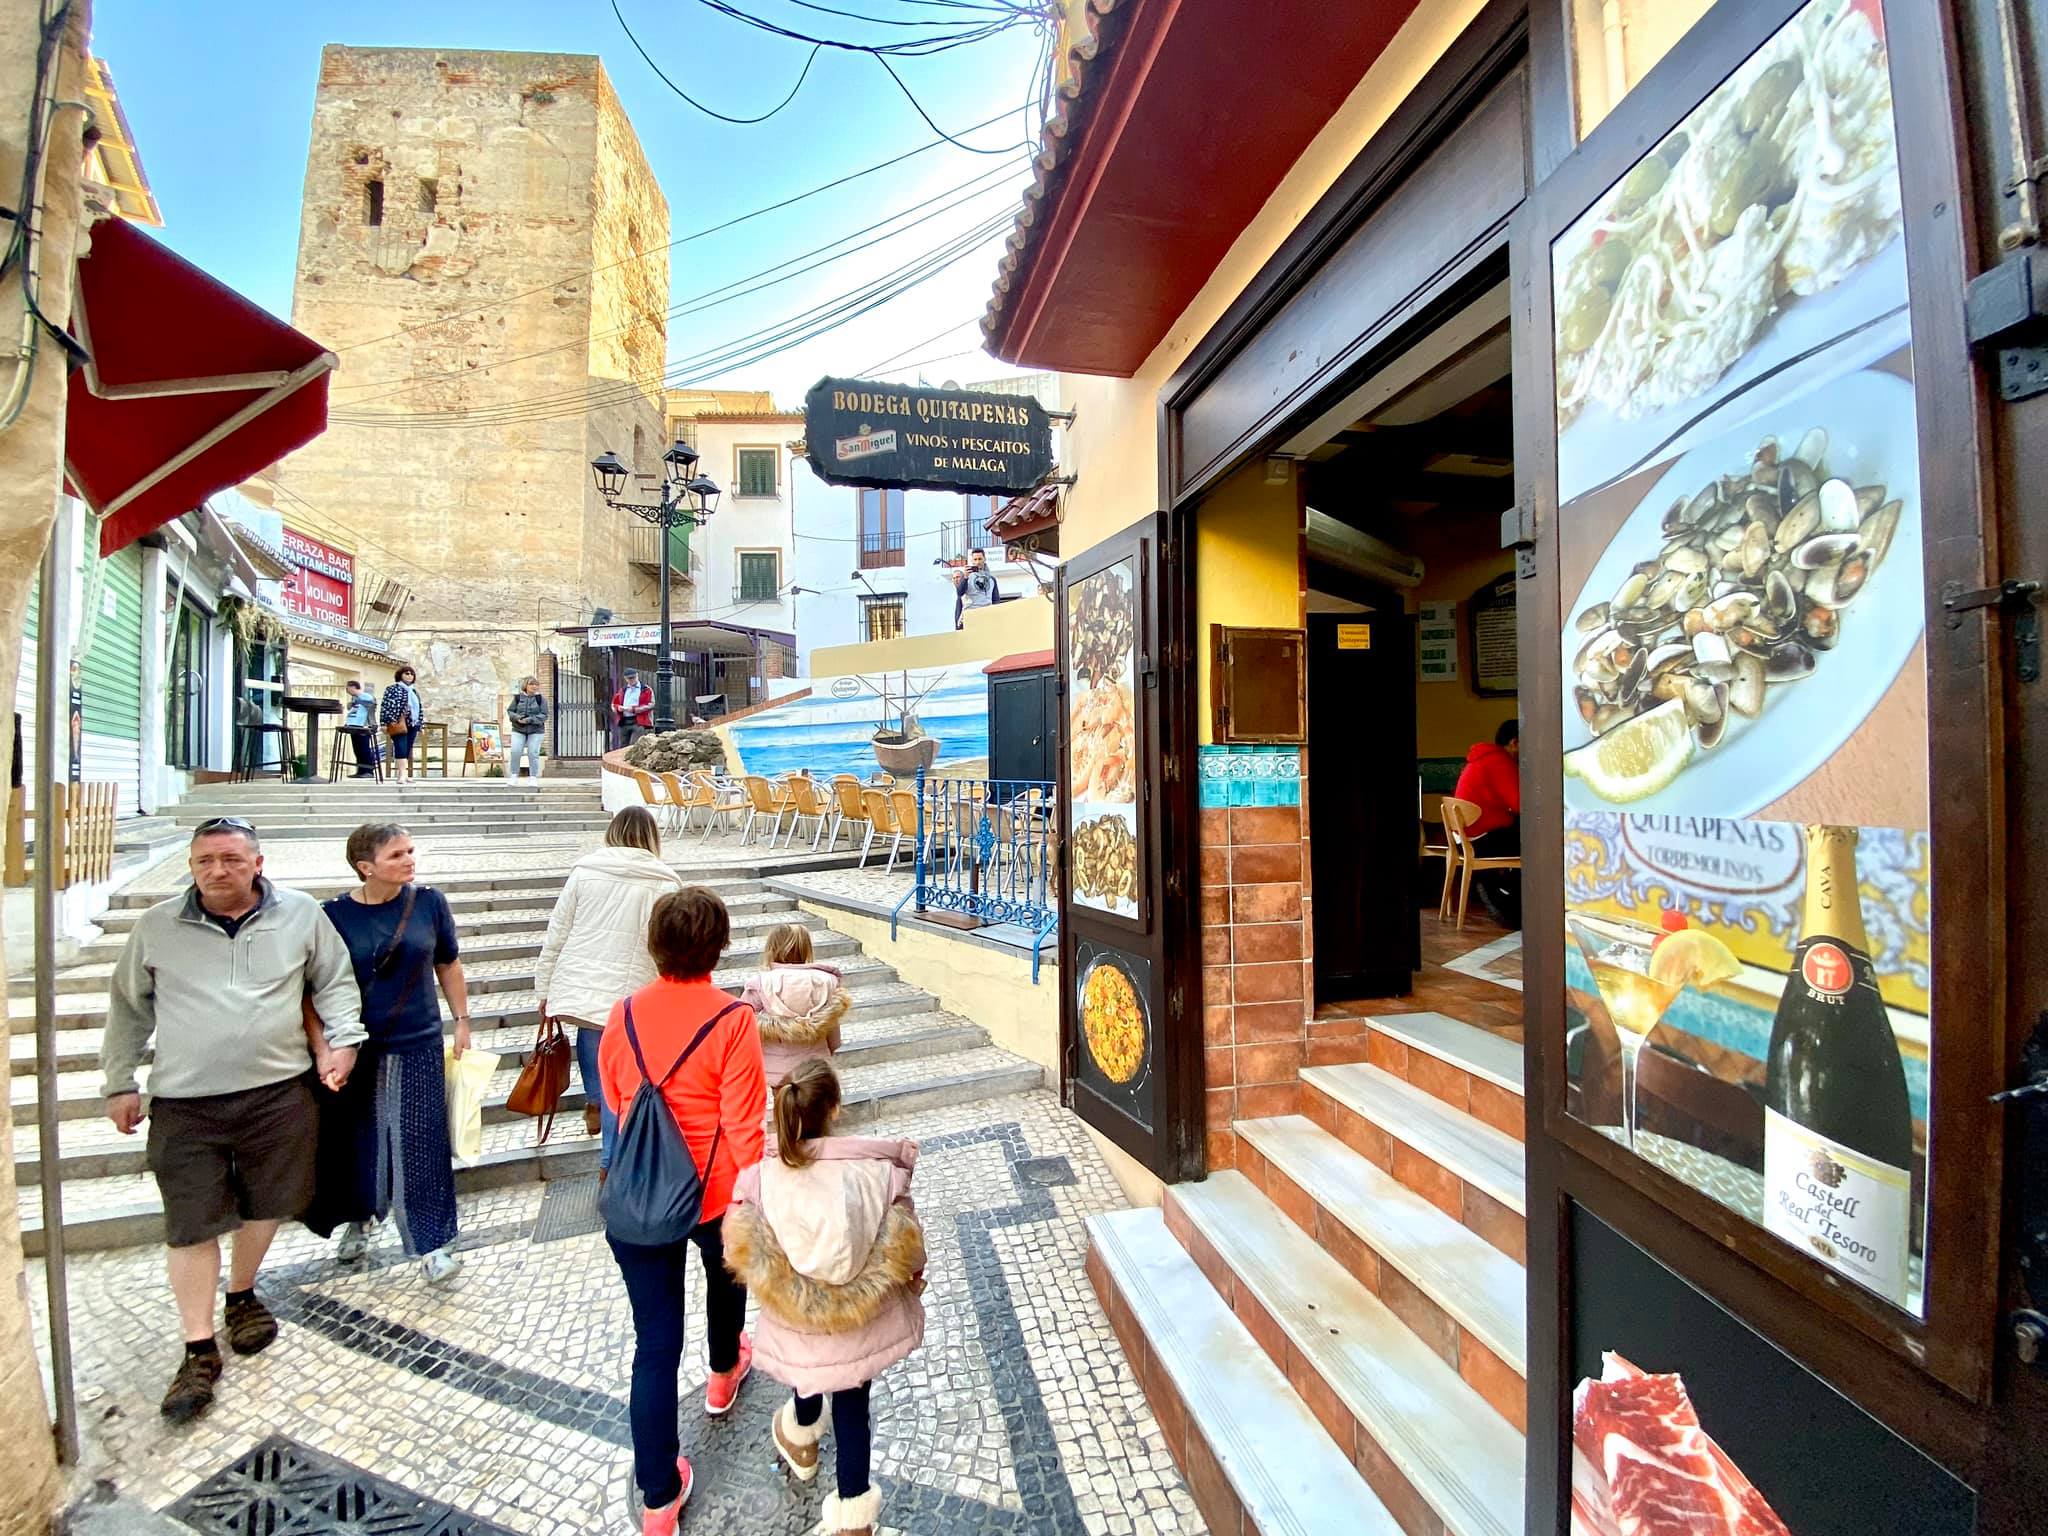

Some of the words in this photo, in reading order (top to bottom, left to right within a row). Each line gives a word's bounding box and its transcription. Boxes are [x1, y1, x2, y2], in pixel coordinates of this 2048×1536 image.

[833, 391, 911, 416] BODEGA
[917, 398, 1030, 427] QUITAPENAS
[906, 433, 949, 449] VINOS
[962, 437, 1031, 455] PESCAITOS
[934, 457, 949, 468] DE
[952, 457, 1006, 473] MALAGA
[281, 596, 296, 612] DE
[299, 602, 313, 617] LA
[315, 607, 349, 627] TORRE
[307, 585, 344, 607] MOLINO
[1630, 813, 1786, 853] QUITAPENAS
[1648, 845, 1764, 883] TORREMOLINOS
[1820, 866, 1832, 910] CAVA
[1806, 988, 1845, 1005] BRUT
[1795, 1172, 1861, 1218] Castell
[1814, 1203, 1834, 1220] del
[1779, 1190, 1815, 1223] Real
[1819, 1219, 1877, 1263] Tesoro
